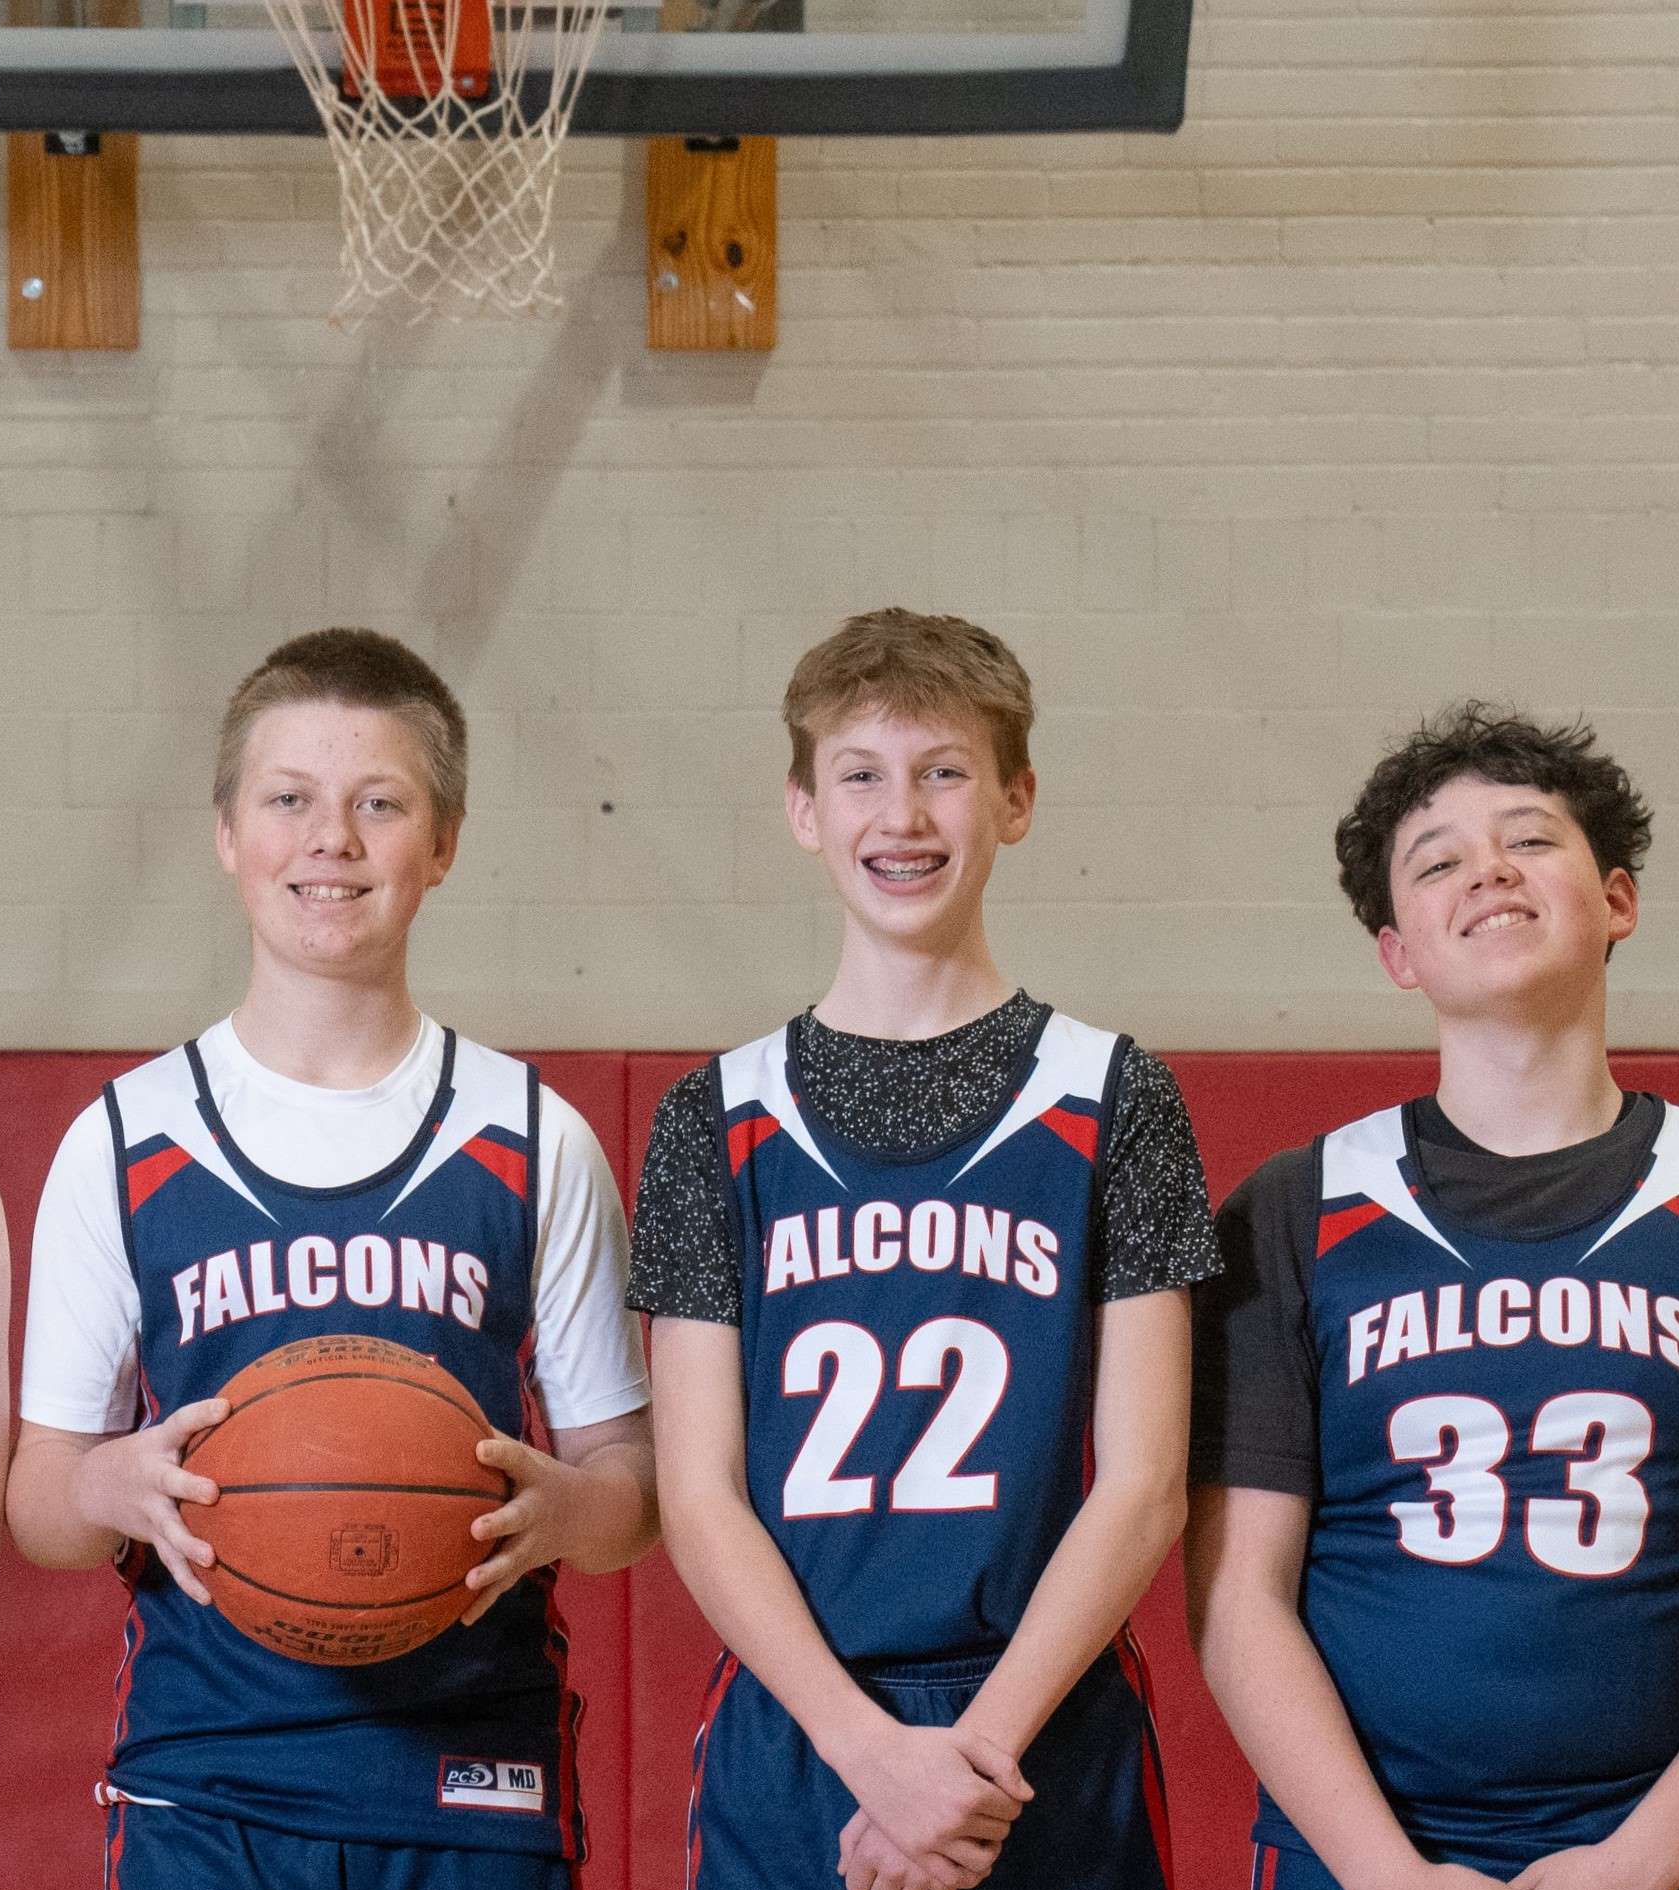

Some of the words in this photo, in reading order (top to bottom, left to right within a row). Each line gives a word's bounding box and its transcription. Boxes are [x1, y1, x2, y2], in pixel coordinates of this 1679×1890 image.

[172, 1234, 488, 1345] FALCONS
[763, 1200, 1060, 1297] ALCONS
[781, 1315, 1011, 1520] 22
[1387, 1390, 1656, 1580] 33
[447, 1770, 480, 1784] PCS
[508, 1768, 535, 1789] MD
